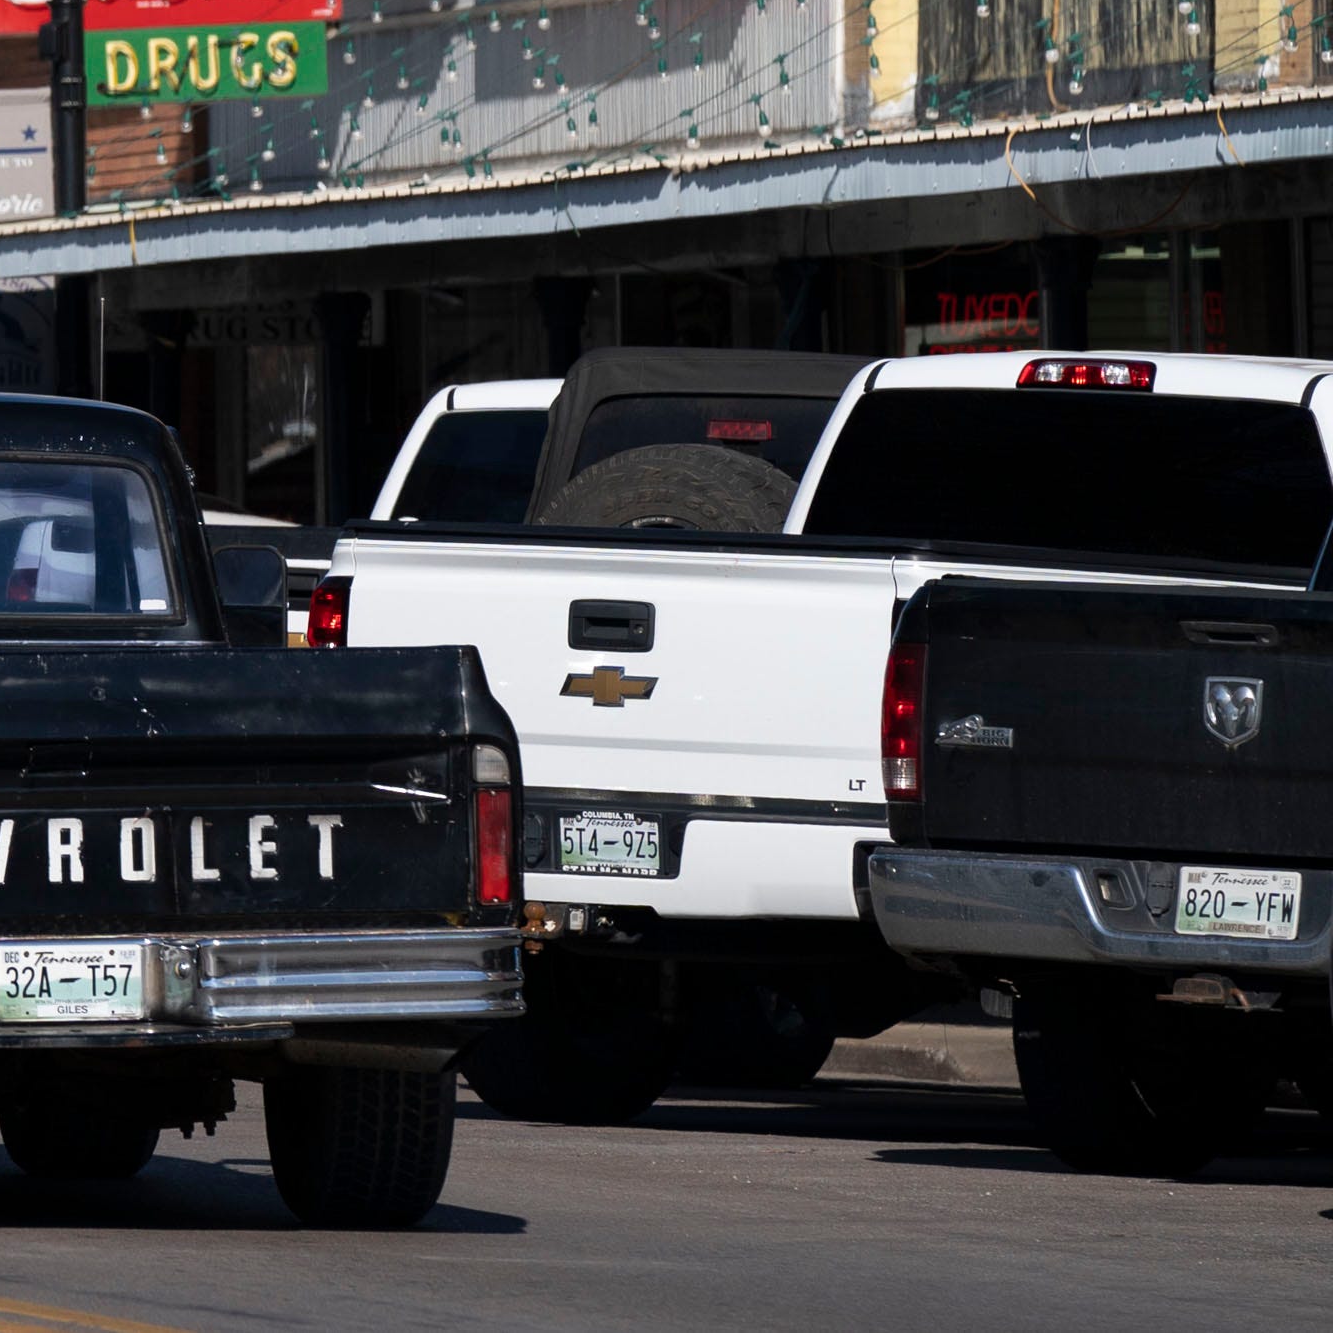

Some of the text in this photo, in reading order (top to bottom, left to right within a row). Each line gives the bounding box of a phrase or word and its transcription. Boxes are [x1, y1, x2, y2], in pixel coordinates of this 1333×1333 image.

[105, 30, 300, 93] DRUGS
[13, 157, 34, 168] TO
[982, 729, 1006, 738] BIG
[848, 778, 868, 793] LT
[581, 810, 635, 821] COLUMBIA, TN
[586, 818, 636, 828] Tennessee
[1211, 872, 1270, 886] Tennessee
[1212, 921, 1263, 935] LAWRENCE
[4, 951, 20, 964] DEC
[33, 951, 105, 967] Tennessee
[56, 1004, 89, 1015] GILES
